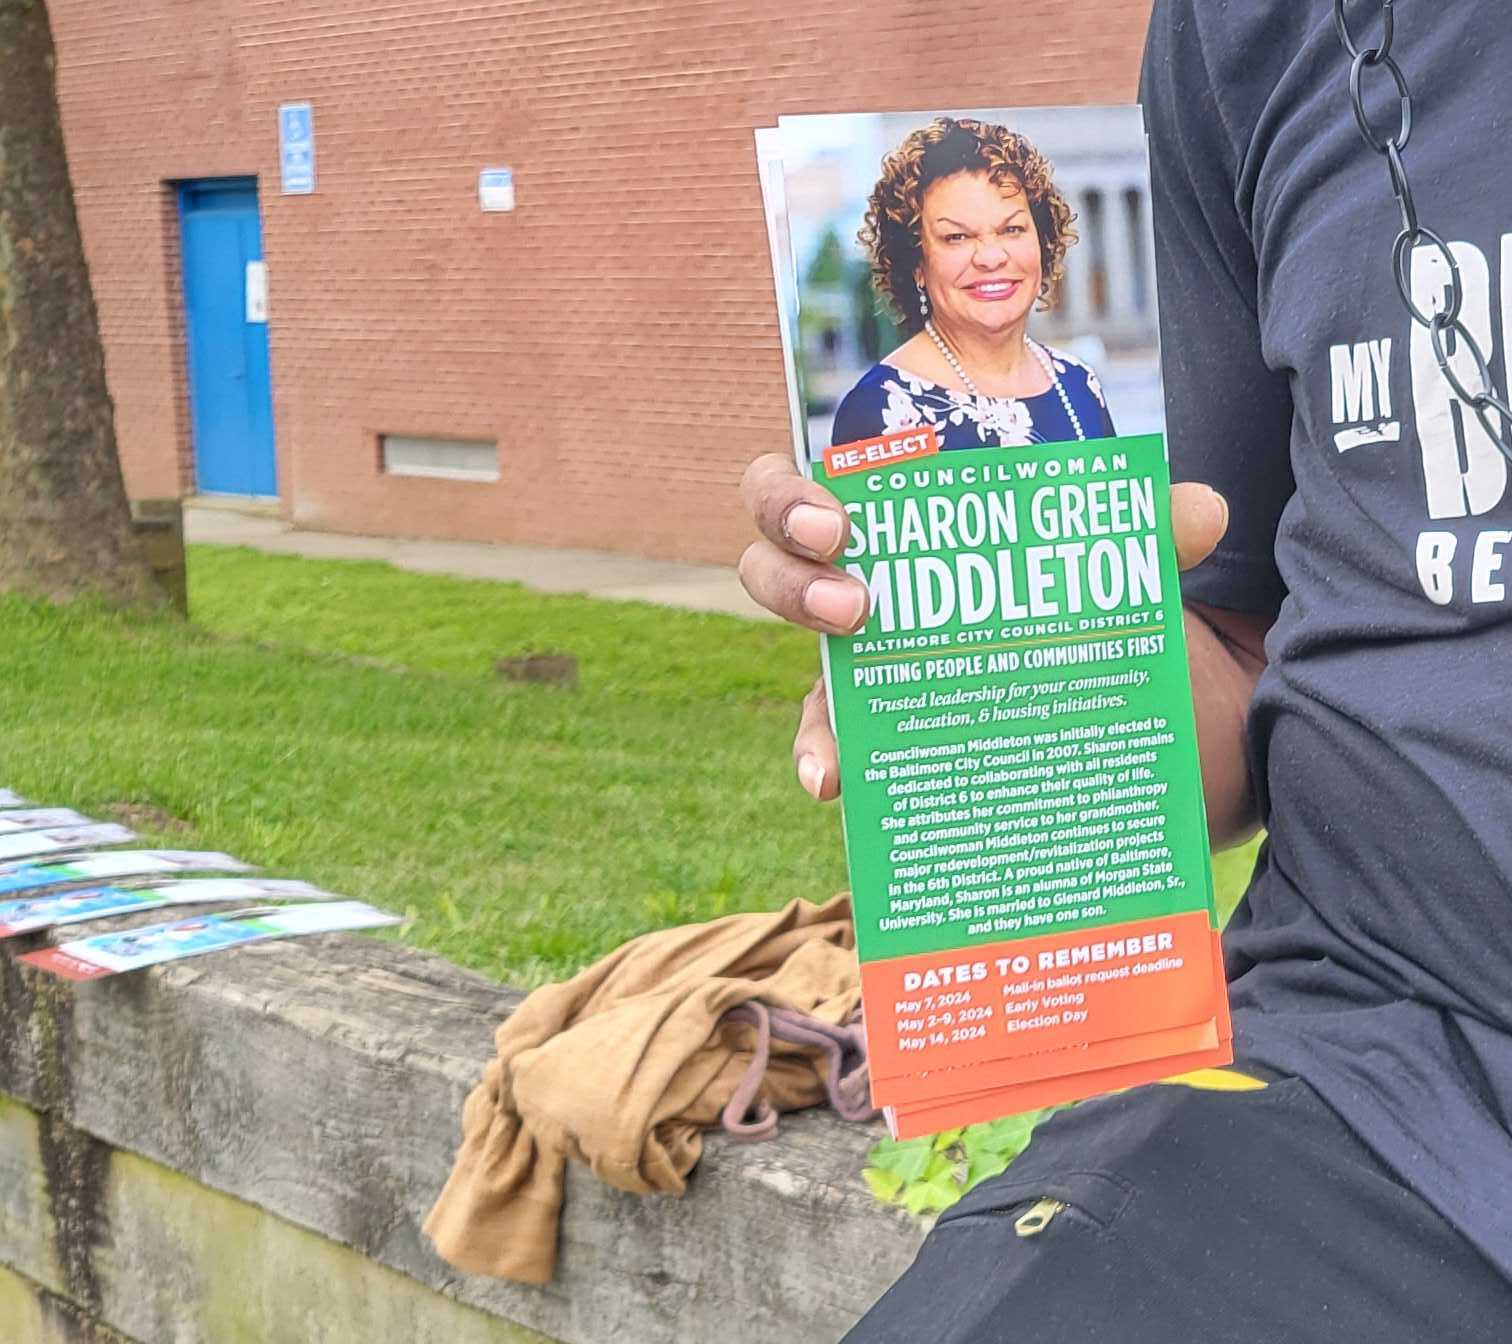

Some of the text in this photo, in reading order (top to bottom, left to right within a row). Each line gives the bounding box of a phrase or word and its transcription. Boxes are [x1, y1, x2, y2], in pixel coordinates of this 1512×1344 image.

[1330, 338, 1392, 423] MY
[832, 434, 929, 470] RE-ELECT
[867, 454, 1127, 491] COUNCILWOMAN
[844, 477, 1156, 557] SHARON GREEN
[845, 534, 1162, 635] MIDDLETON
[853, 610, 1163, 653] BALTIMORE CITY COUNCIL DISTRICT 6
[853, 634, 1164, 687] PUTTING PEOPLE AND COMMUNITIES FIRST
[868, 669, 1149, 713] Trusted leadership for your community,
[897, 694, 1126, 732] education, & housing initiatives.
[864, 732, 1174, 781] the Baltimore City Council in 2007. Sharon remains
[870, 717, 1166, 763] Councilwoman Middleton was initially elected to
[887, 751, 1157, 795] dedicated to collaborating with all residents
[893, 766, 1154, 812] of District 6 to enhance their quality of life.
[881, 782, 1167, 830] She attributes her commitment to philanthropy
[893, 800, 1159, 845] and community service to her grandmother.
[889, 815, 1165, 862] Councilwoman Middleton continues to secure
[894, 830, 1164, 878] major redevelopment/revitalization projects
[888, 846, 1171, 896] in the 6th District. A proud native of Baltimore,
[890, 861, 1172, 913] Maryland, Sharon is an alumna of Morgan State
[879, 875, 1185, 931] University. She is married to Glenard Middleton, Sr.,
[968, 905, 1106, 934] and they have one son.
[904, 932, 1172, 991] DATES TO REMEMBER
[1003, 957, 1183, 995] Mail-in ballot request deadline
[895, 991, 971, 1013] May 7, 2024
[897, 1006, 992, 1031] May 2-9, 2024
[1005, 992, 1084, 1014] Early Voting
[1007, 1010, 1087, 1032] Election Day
[899, 1025, 986, 1050] May 14, 2024
